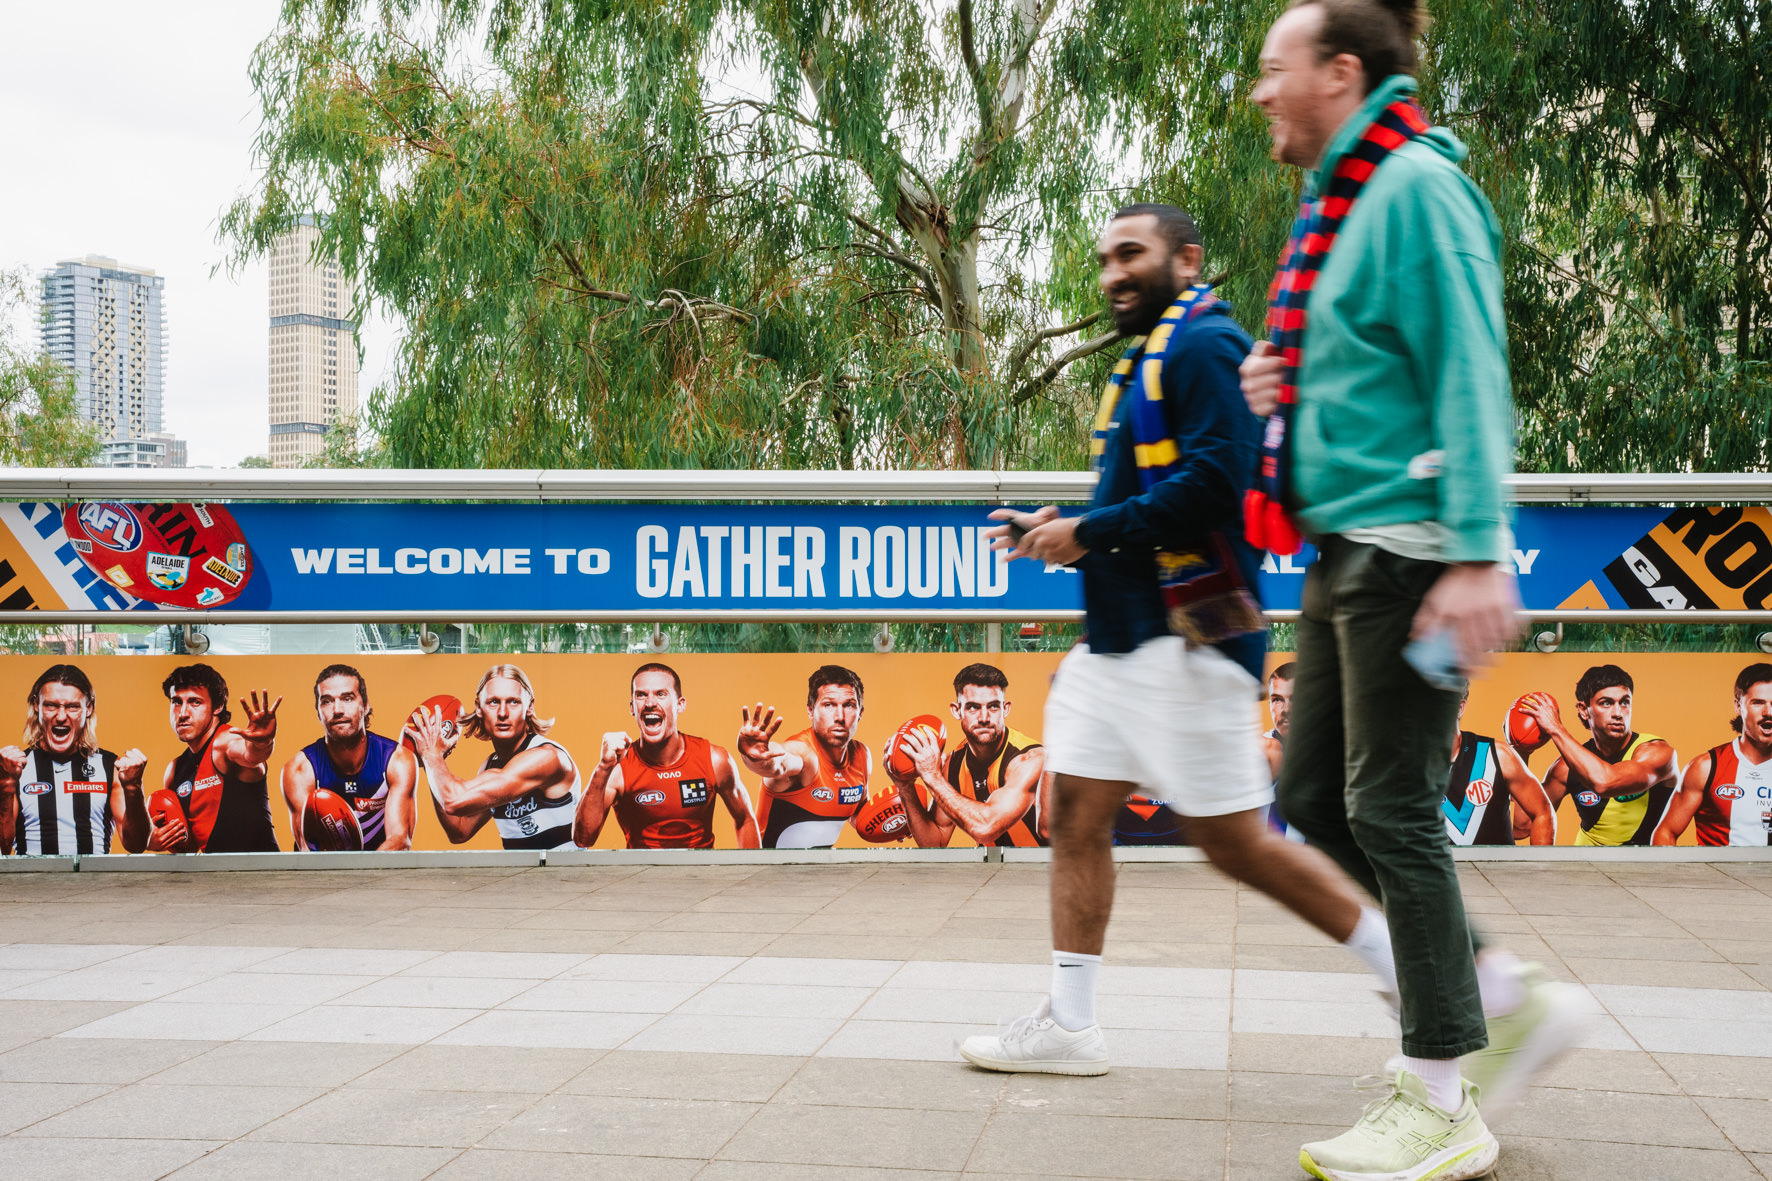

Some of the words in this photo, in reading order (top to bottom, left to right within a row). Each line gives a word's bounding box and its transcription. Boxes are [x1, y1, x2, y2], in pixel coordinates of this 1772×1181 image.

[80, 503, 131, 549] AFL
[151, 556, 186, 569] ADELAIDE
[290, 548, 532, 575] WELCOME
[545, 548, 611, 575] TO
[636, 525, 826, 598] GATHER
[839, 525, 1009, 598] ROUND
[206, 559, 240, 585] ADELAIDE
[1622, 546, 1696, 609] GA
[25, 783, 50, 793] AFL
[67, 783, 104, 791] Emirates
[178, 783, 191, 794] AFL
[841, 788, 860, 796] TOYO
[1467, 781, 1492, 805] MG
[1717, 786, 1743, 798] AFL
[638, 791, 664, 803] AFL
[813, 789, 833, 799] AFL
[1579, 794, 1599, 803] AFL
[505, 797, 538, 818] Ford
[864, 803, 905, 834] SHERR
[885, 815, 906, 832] AFL
